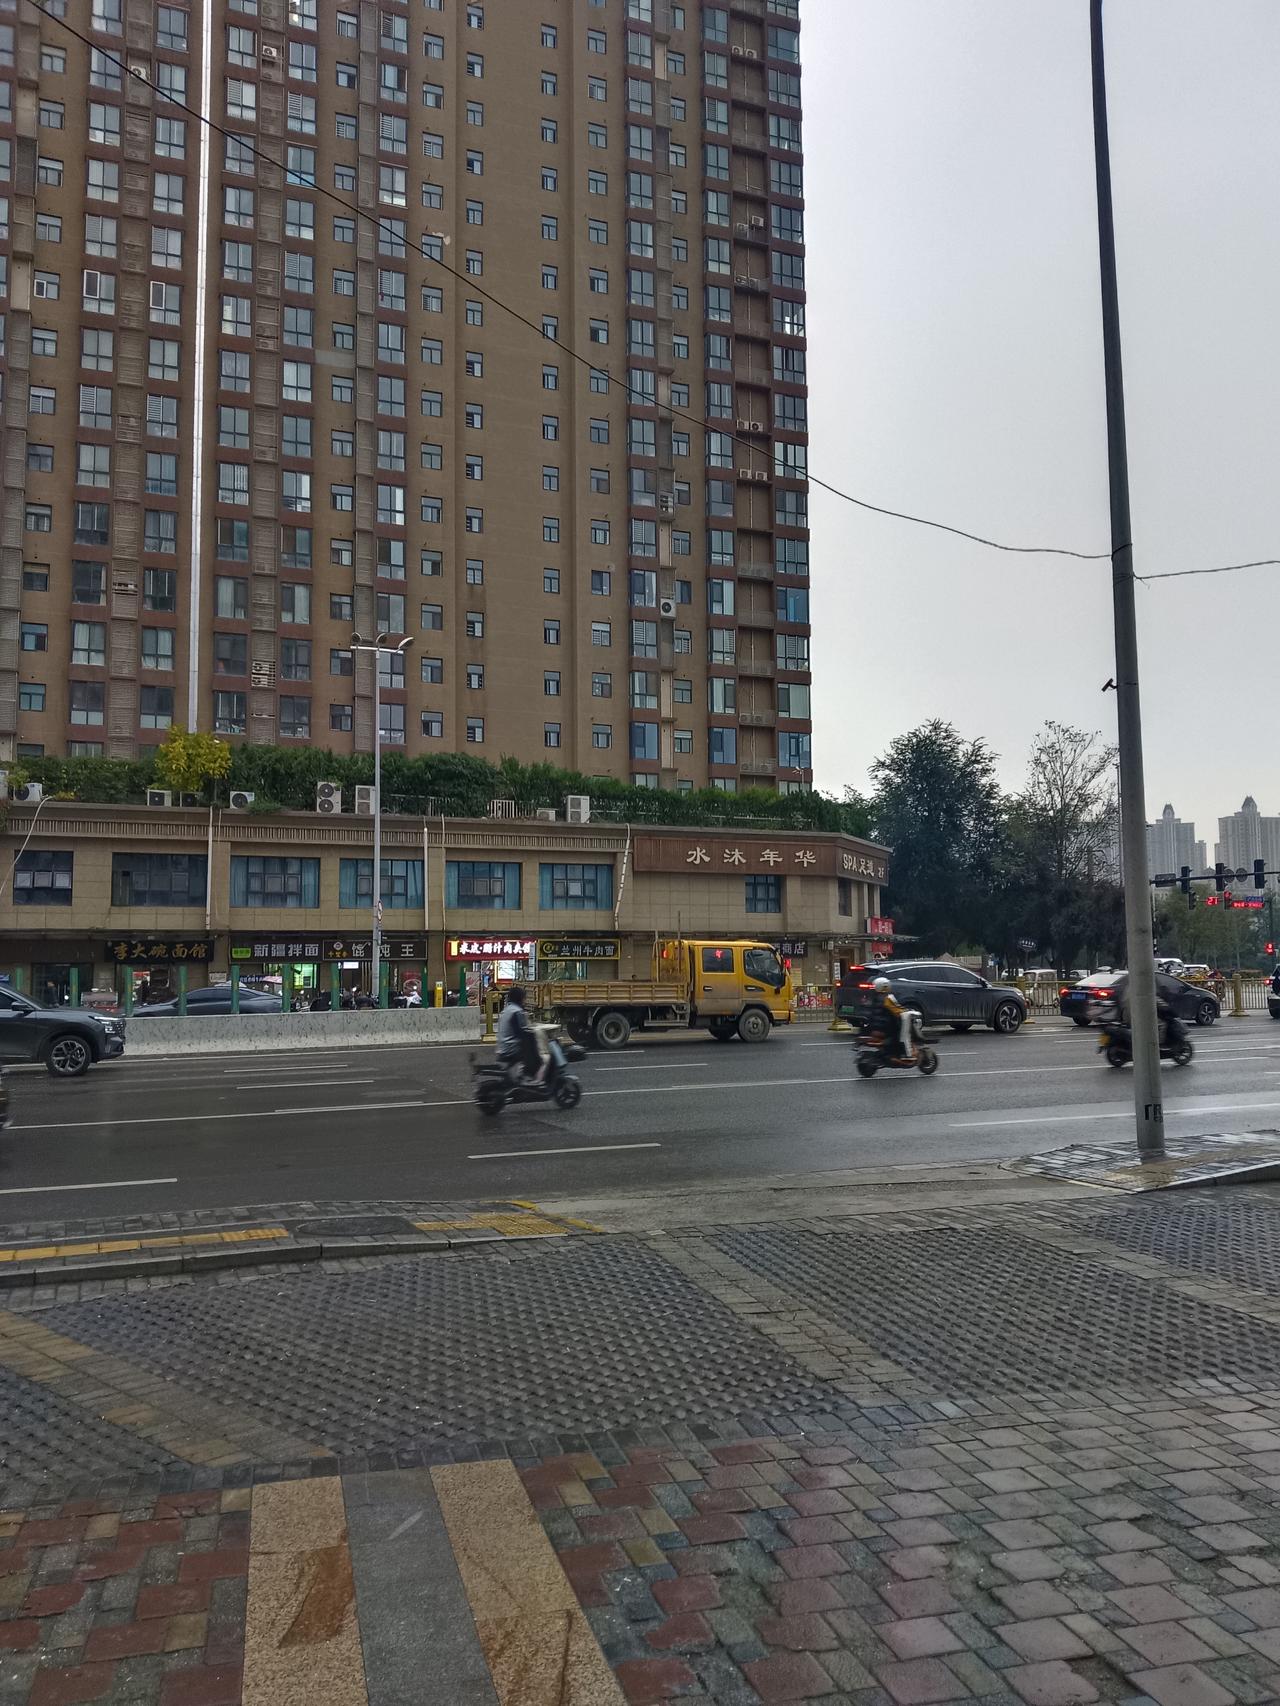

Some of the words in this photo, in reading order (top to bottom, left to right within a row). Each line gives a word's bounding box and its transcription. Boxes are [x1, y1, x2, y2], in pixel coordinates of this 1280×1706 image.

[686, 846, 817, 868] 水沐年华
[254, 943, 319, 957] 新疆拌面
[560, 944, 615, 956] 兰州牛肉面
